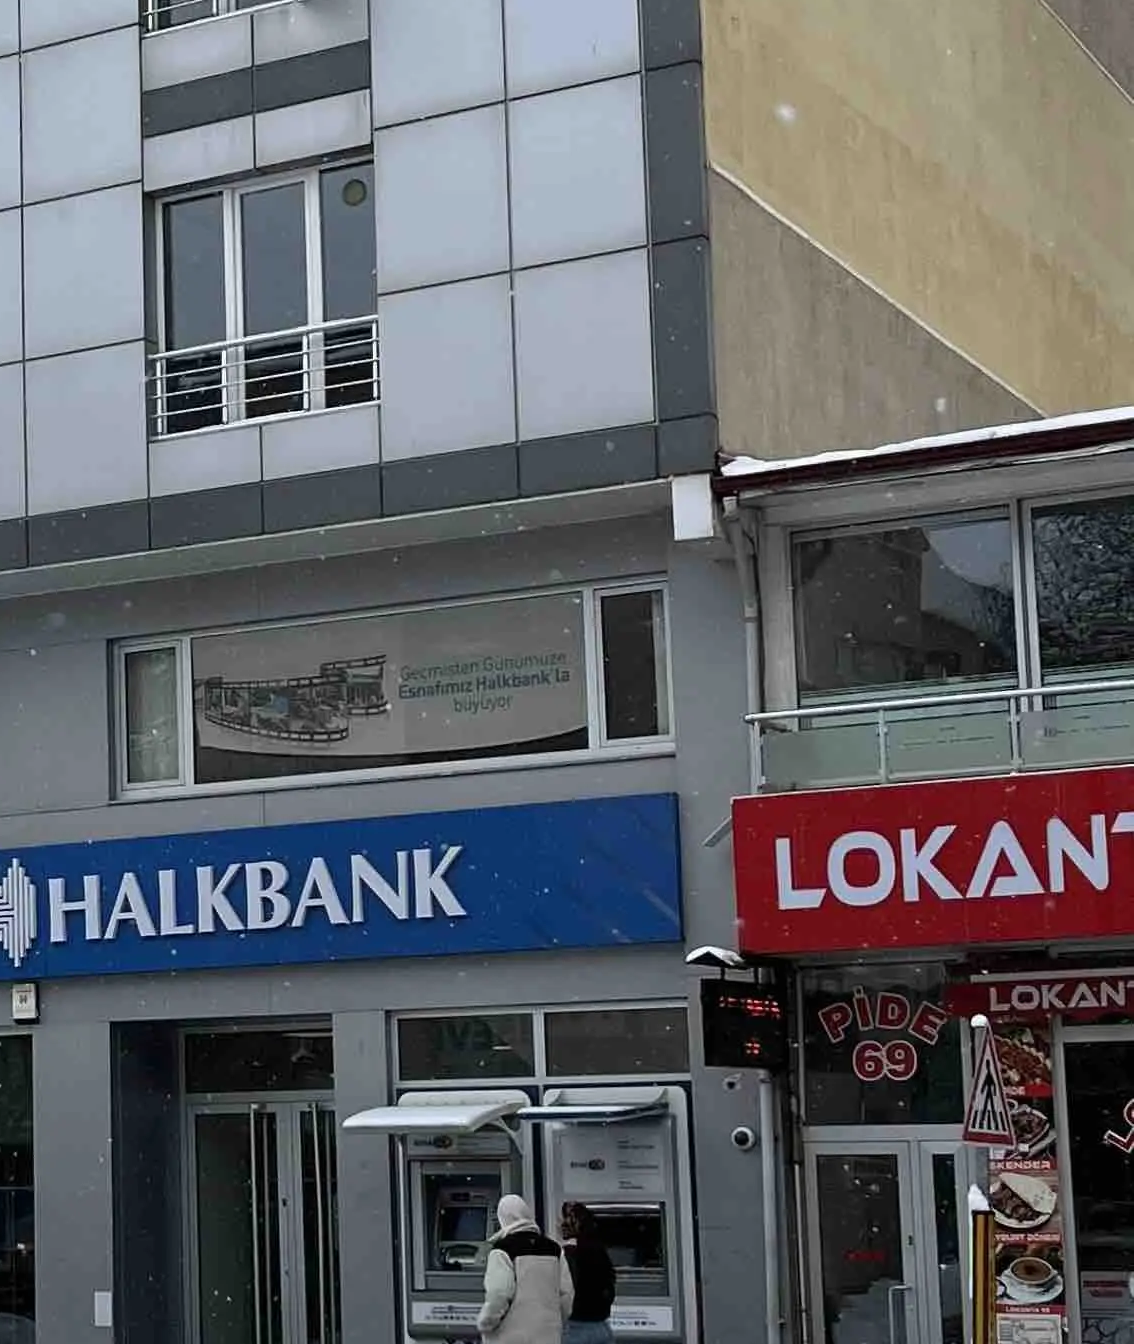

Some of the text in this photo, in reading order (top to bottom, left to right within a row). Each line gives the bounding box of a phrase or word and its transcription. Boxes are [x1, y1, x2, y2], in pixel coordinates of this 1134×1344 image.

[49, 845, 466, 943] HALKBANK
[818, 985, 948, 1045] PİDE
[852, 1040, 918, 1081] 69
